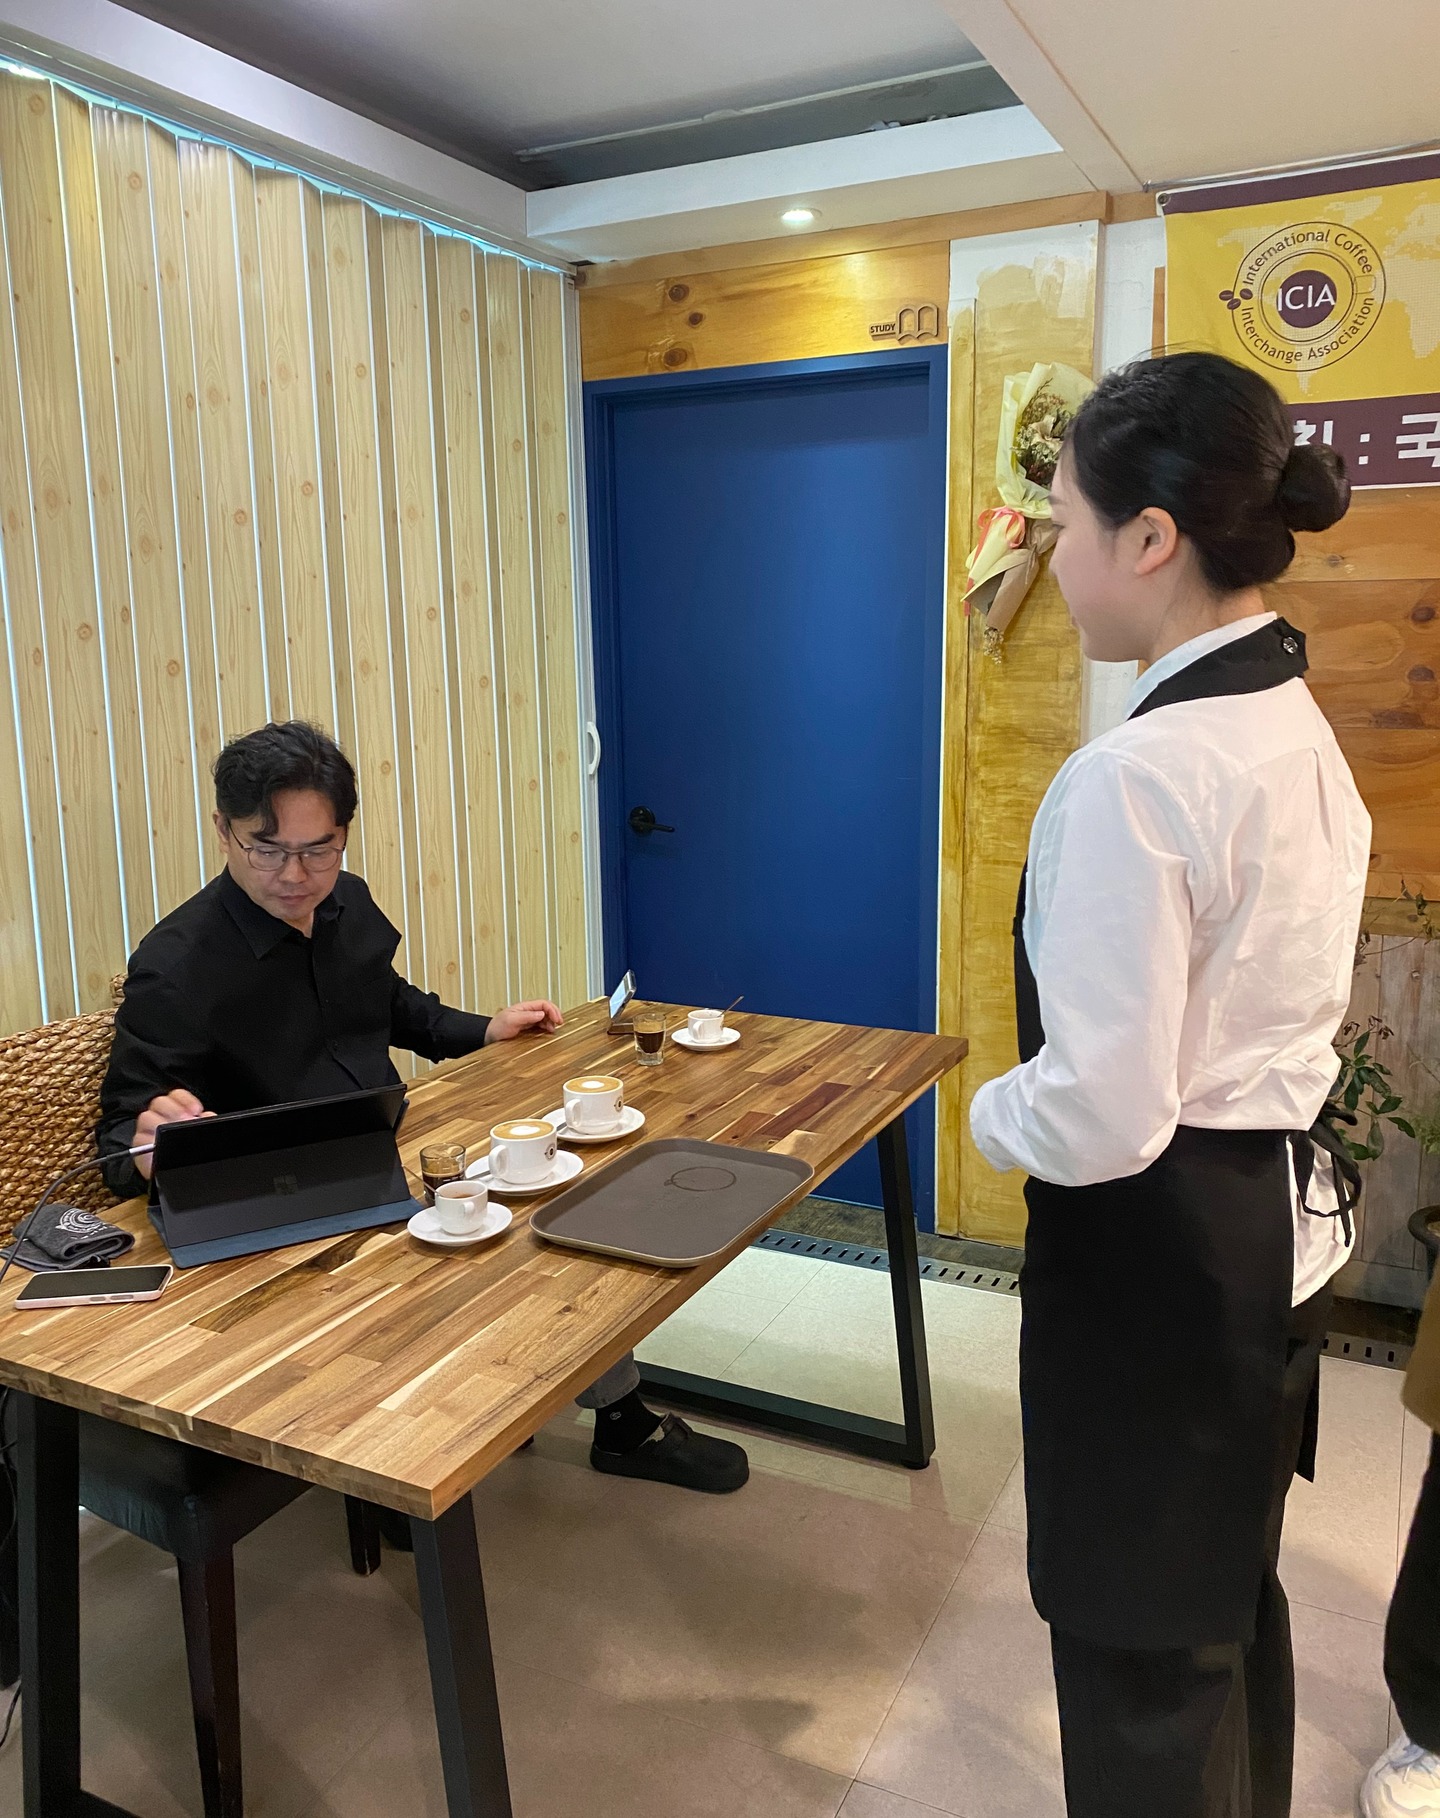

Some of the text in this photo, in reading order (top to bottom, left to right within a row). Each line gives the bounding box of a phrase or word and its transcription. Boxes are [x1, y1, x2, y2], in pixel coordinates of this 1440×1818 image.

[1243, 229, 1372, 286] International Coffee
[1277, 283, 1336, 312] ICIA
[870, 323, 896, 334] STUDY
[1241, 297, 1375, 364] Interchange Association
